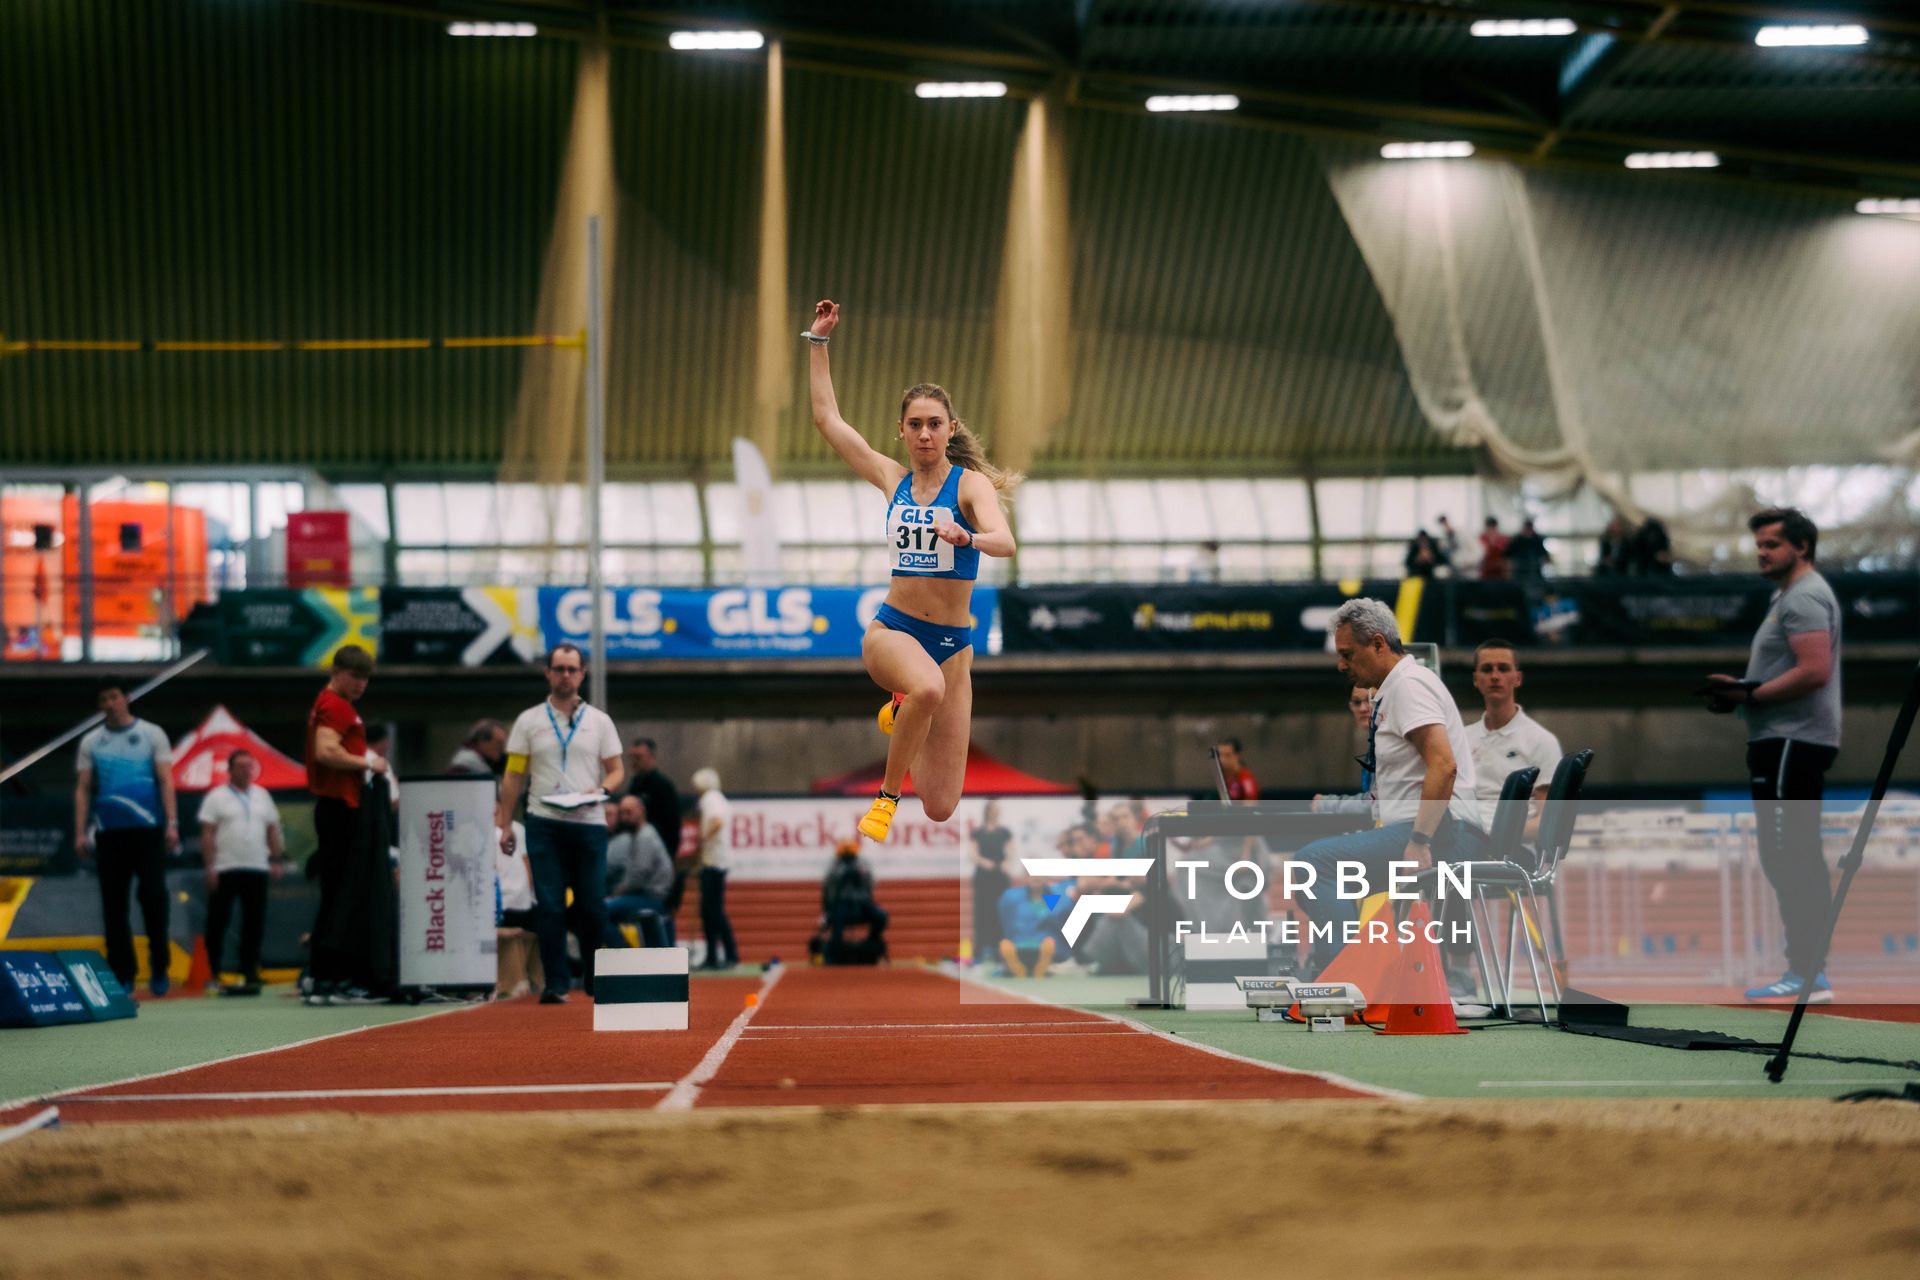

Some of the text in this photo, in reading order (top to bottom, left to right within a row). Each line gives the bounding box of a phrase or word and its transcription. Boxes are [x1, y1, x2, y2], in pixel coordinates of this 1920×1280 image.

[896, 525, 939, 551] 317
[914, 555, 937, 564] PLAN
[731, 812, 836, 849] Black
[425, 810, 445, 952] Black Forest
[1297, 987, 1330, 997] SELTEC
